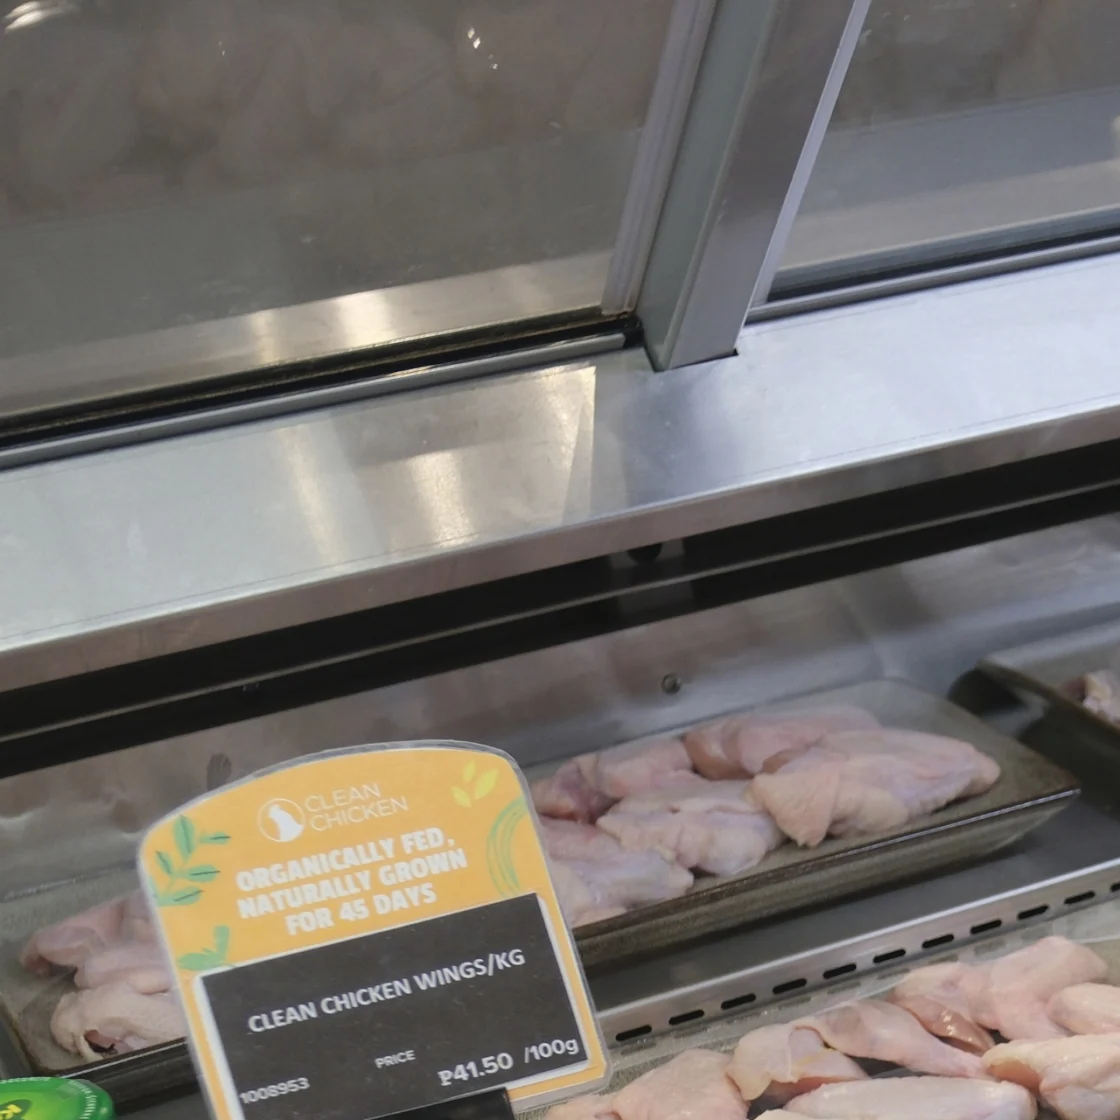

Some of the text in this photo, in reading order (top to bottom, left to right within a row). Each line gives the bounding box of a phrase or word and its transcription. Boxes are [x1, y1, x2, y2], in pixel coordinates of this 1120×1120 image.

[305, 783, 381, 812] CLEAN
[309, 796, 409, 831] CHICKEN
[236, 827, 455, 891] ORGANICALLY FED,
[237, 848, 468, 919] NATURALLY GROWN
[284, 882, 437, 935] FOR 45 DAYS
[248, 949, 526, 1032] CLEAN CHICKEN WINGS/KG
[374, 1050, 416, 1069] PRICE
[524, 1038, 579, 1063] /100g
[240, 1077, 310, 1103] 1008953
